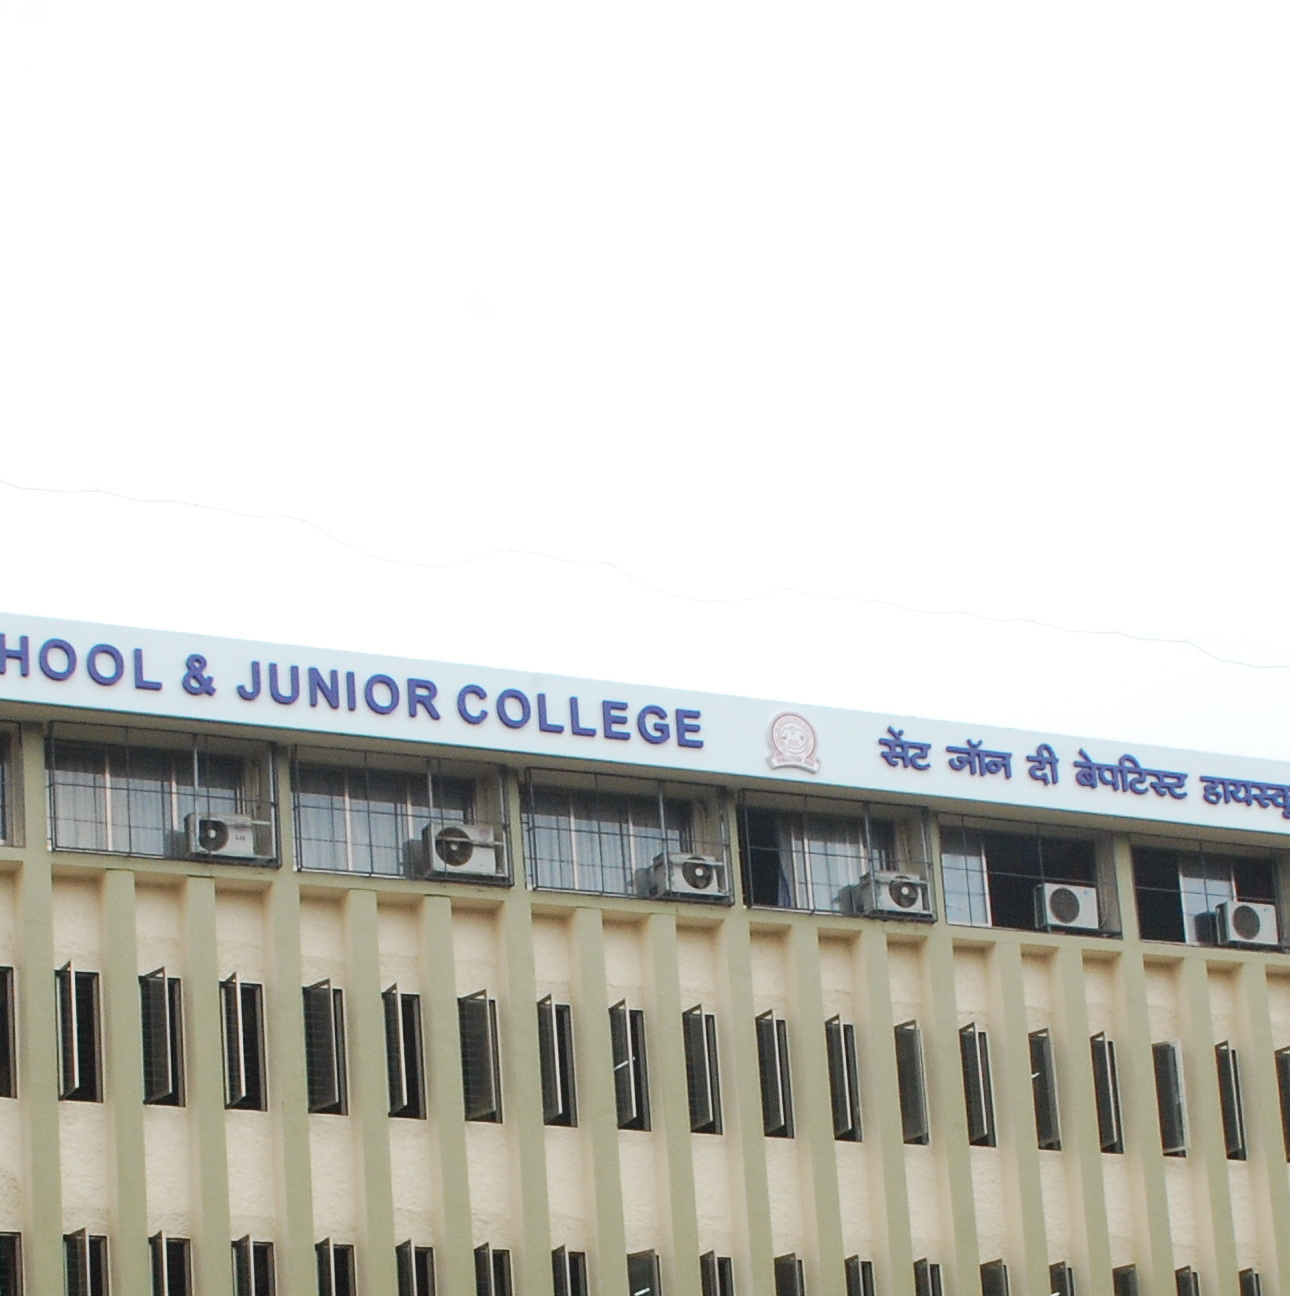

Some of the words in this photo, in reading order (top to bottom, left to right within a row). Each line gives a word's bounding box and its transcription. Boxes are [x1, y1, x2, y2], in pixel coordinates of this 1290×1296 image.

[182, 654, 216, 696] &
[236, 660, 441, 721] JUNIOR
[457, 684, 704, 749] COLLEGE
[946, 739, 1012, 779] जॉन
[1026, 743, 1059, 786] दी
[1073, 749, 1188, 800] बेपटिस्ट
